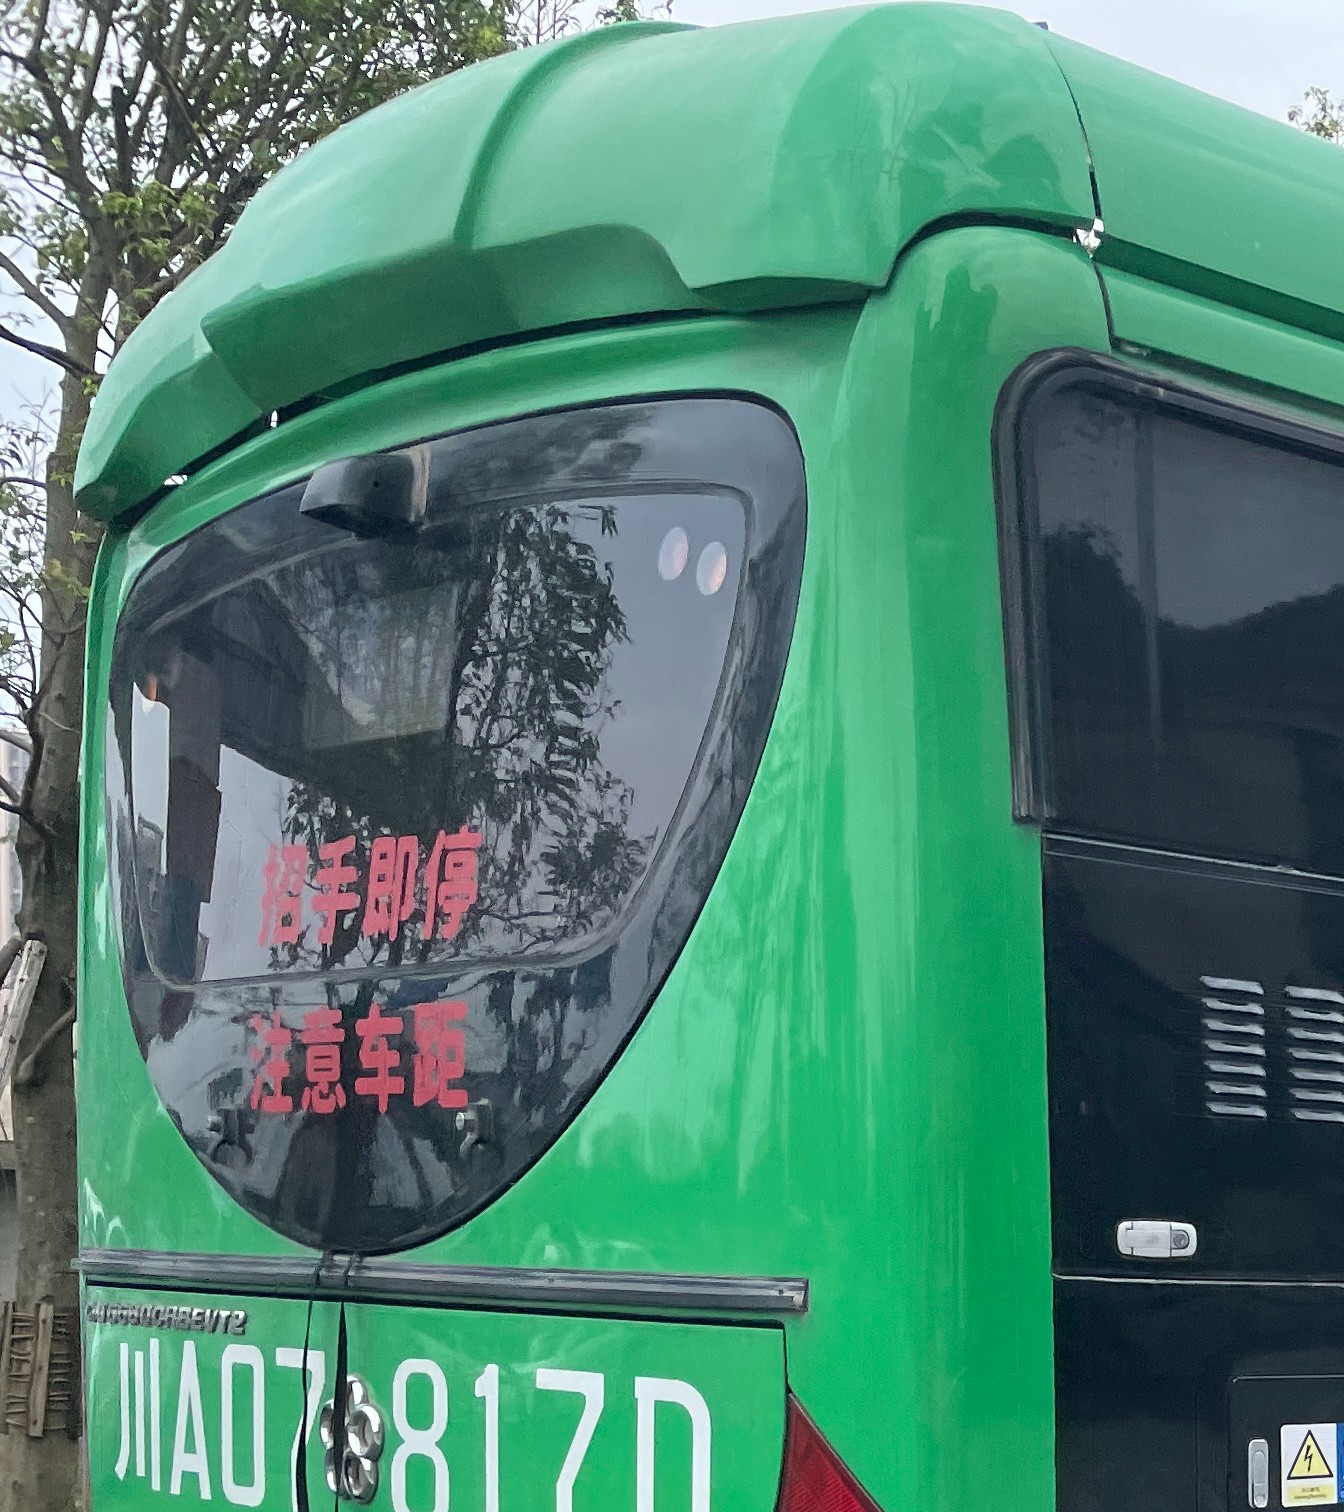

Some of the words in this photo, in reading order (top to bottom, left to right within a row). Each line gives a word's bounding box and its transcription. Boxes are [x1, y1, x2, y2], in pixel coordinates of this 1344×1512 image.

[259, 825, 482, 946] 招手即停
[249, 1003, 468, 1114] 注意车距
